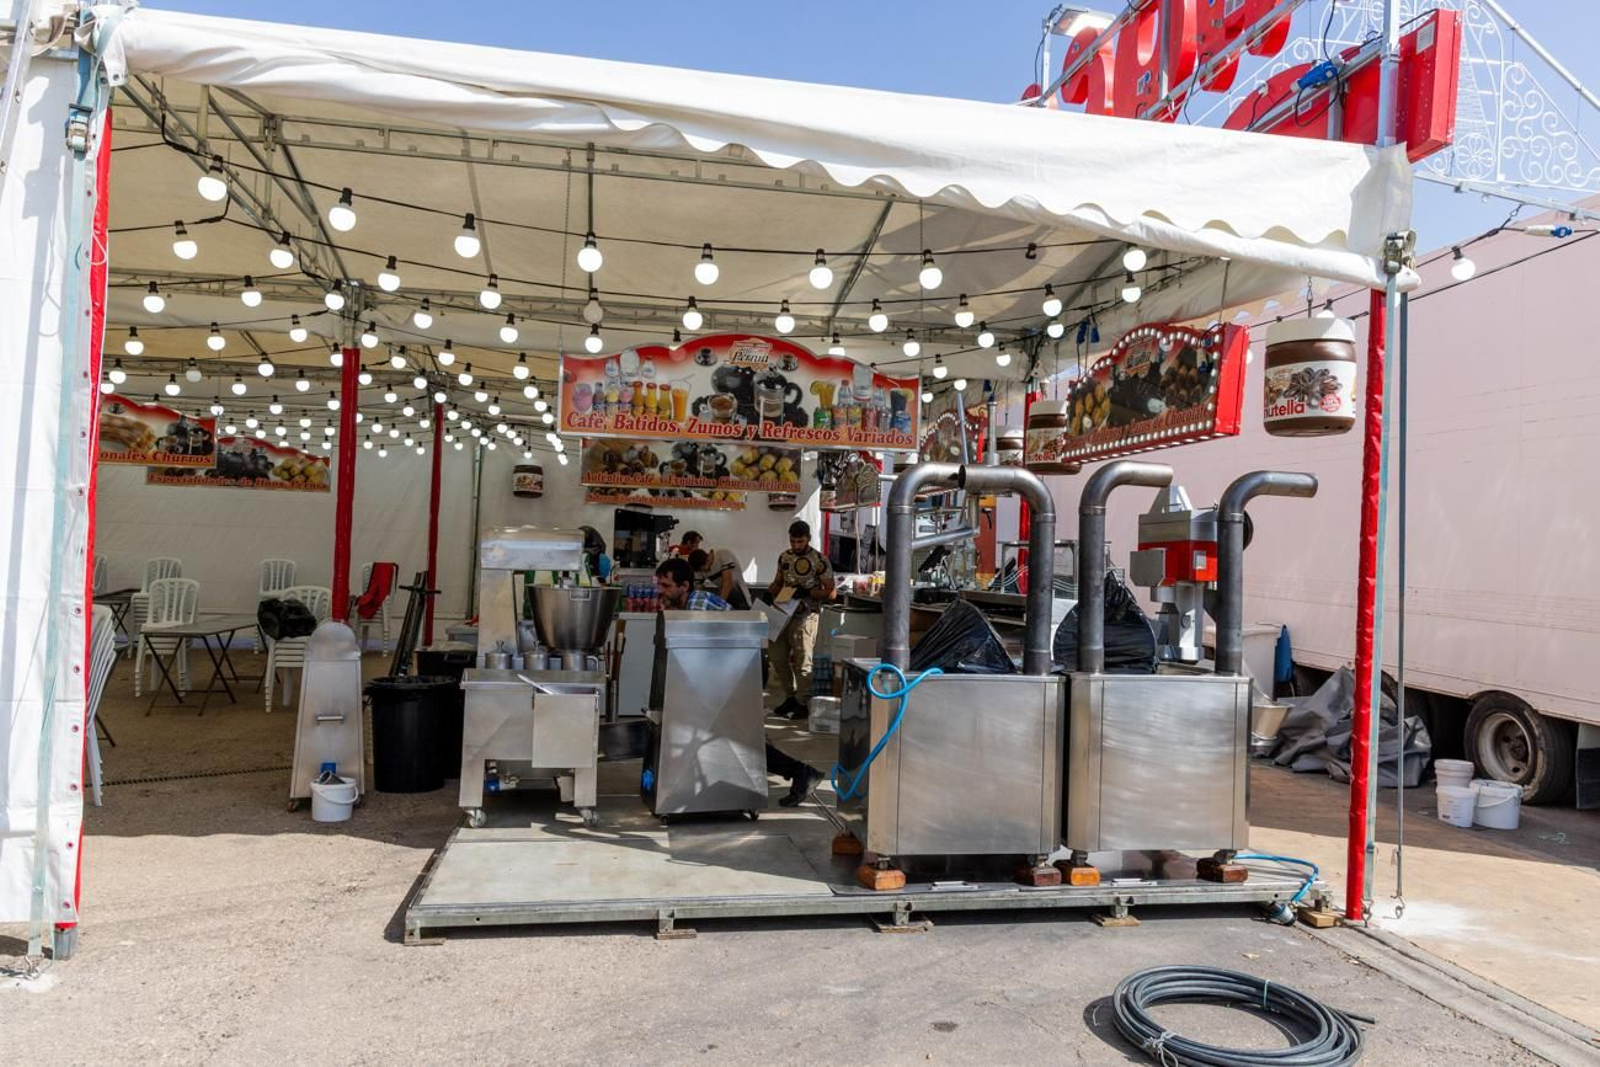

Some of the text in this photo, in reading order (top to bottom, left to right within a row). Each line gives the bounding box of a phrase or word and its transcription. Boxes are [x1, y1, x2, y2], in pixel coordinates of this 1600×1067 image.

[566, 412, 914, 445] Café, Batidos, Zumos y Refrescos Variados
[99, 450, 211, 464] onales Churros
